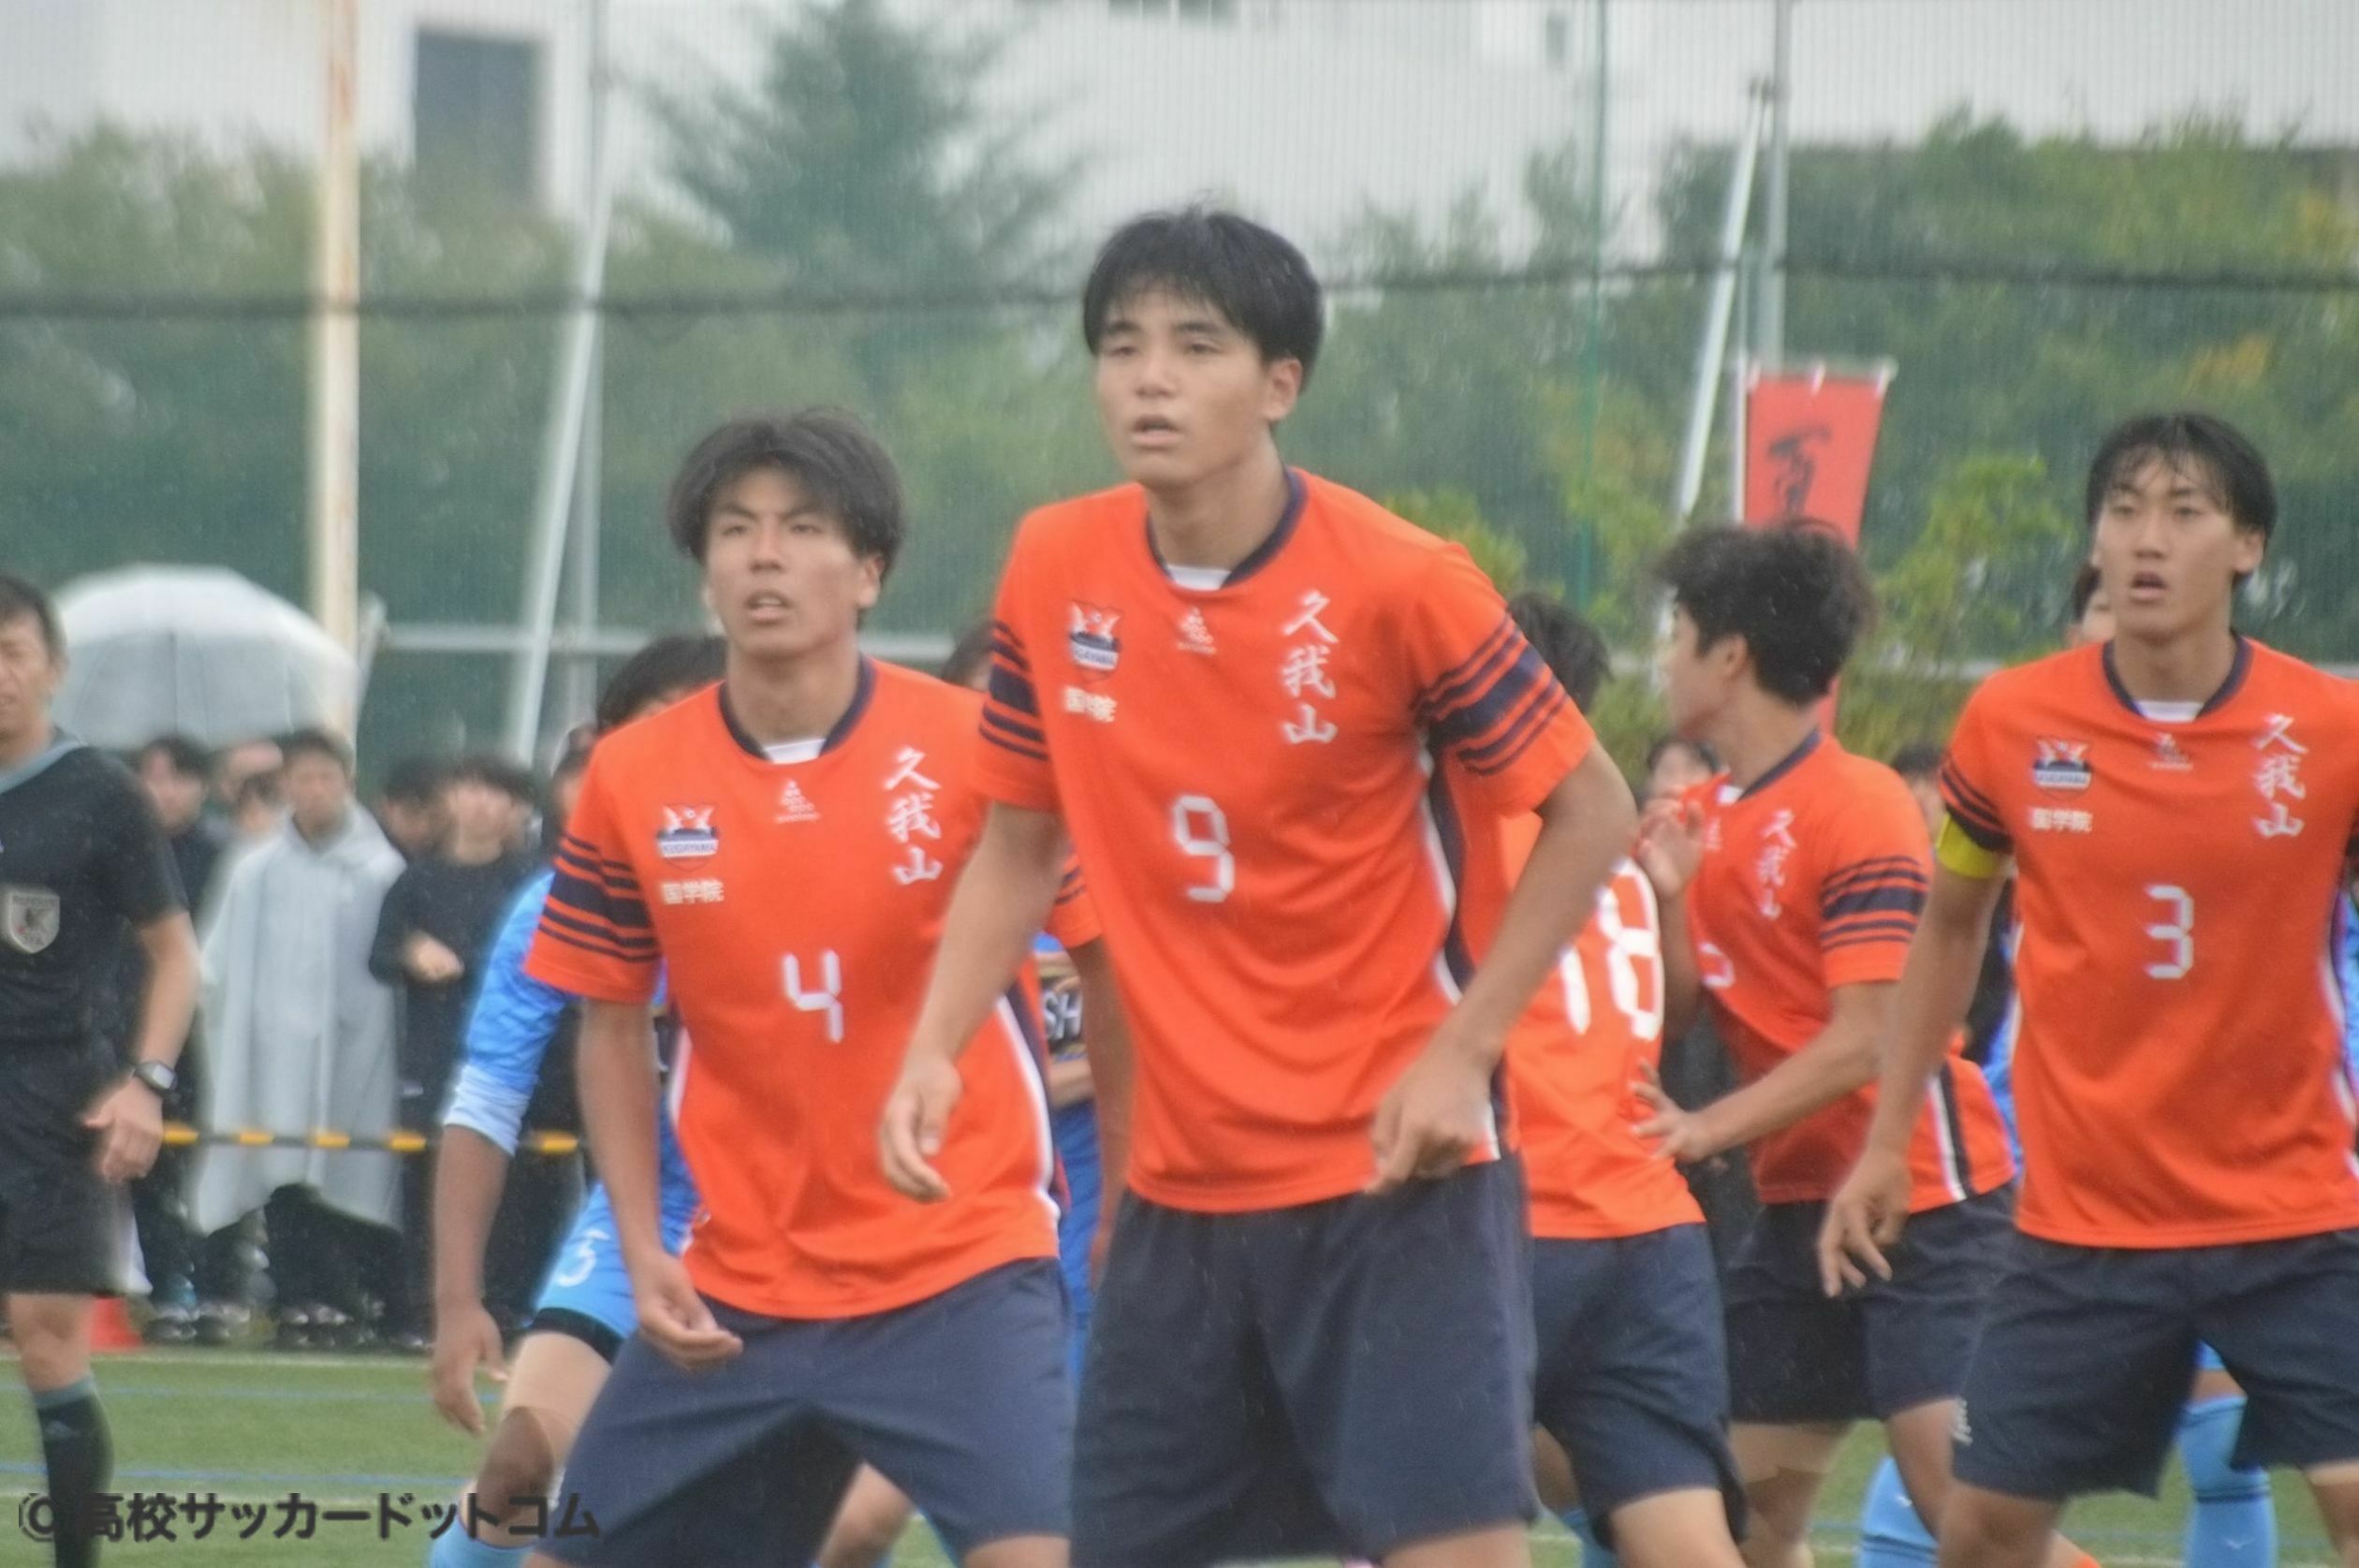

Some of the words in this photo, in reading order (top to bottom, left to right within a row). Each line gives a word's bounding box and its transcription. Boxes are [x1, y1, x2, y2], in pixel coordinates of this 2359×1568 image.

[1282, 590, 1339, 744] 久我山
[884, 746, 942, 886] 久我山
[2253, 713, 2308, 838] 久我山
[662, 880, 724, 904] 国学院
[1172, 795, 1235, 902] 9
[2147, 885, 2193, 979] 3
[782, 949, 842, 1044] 4
